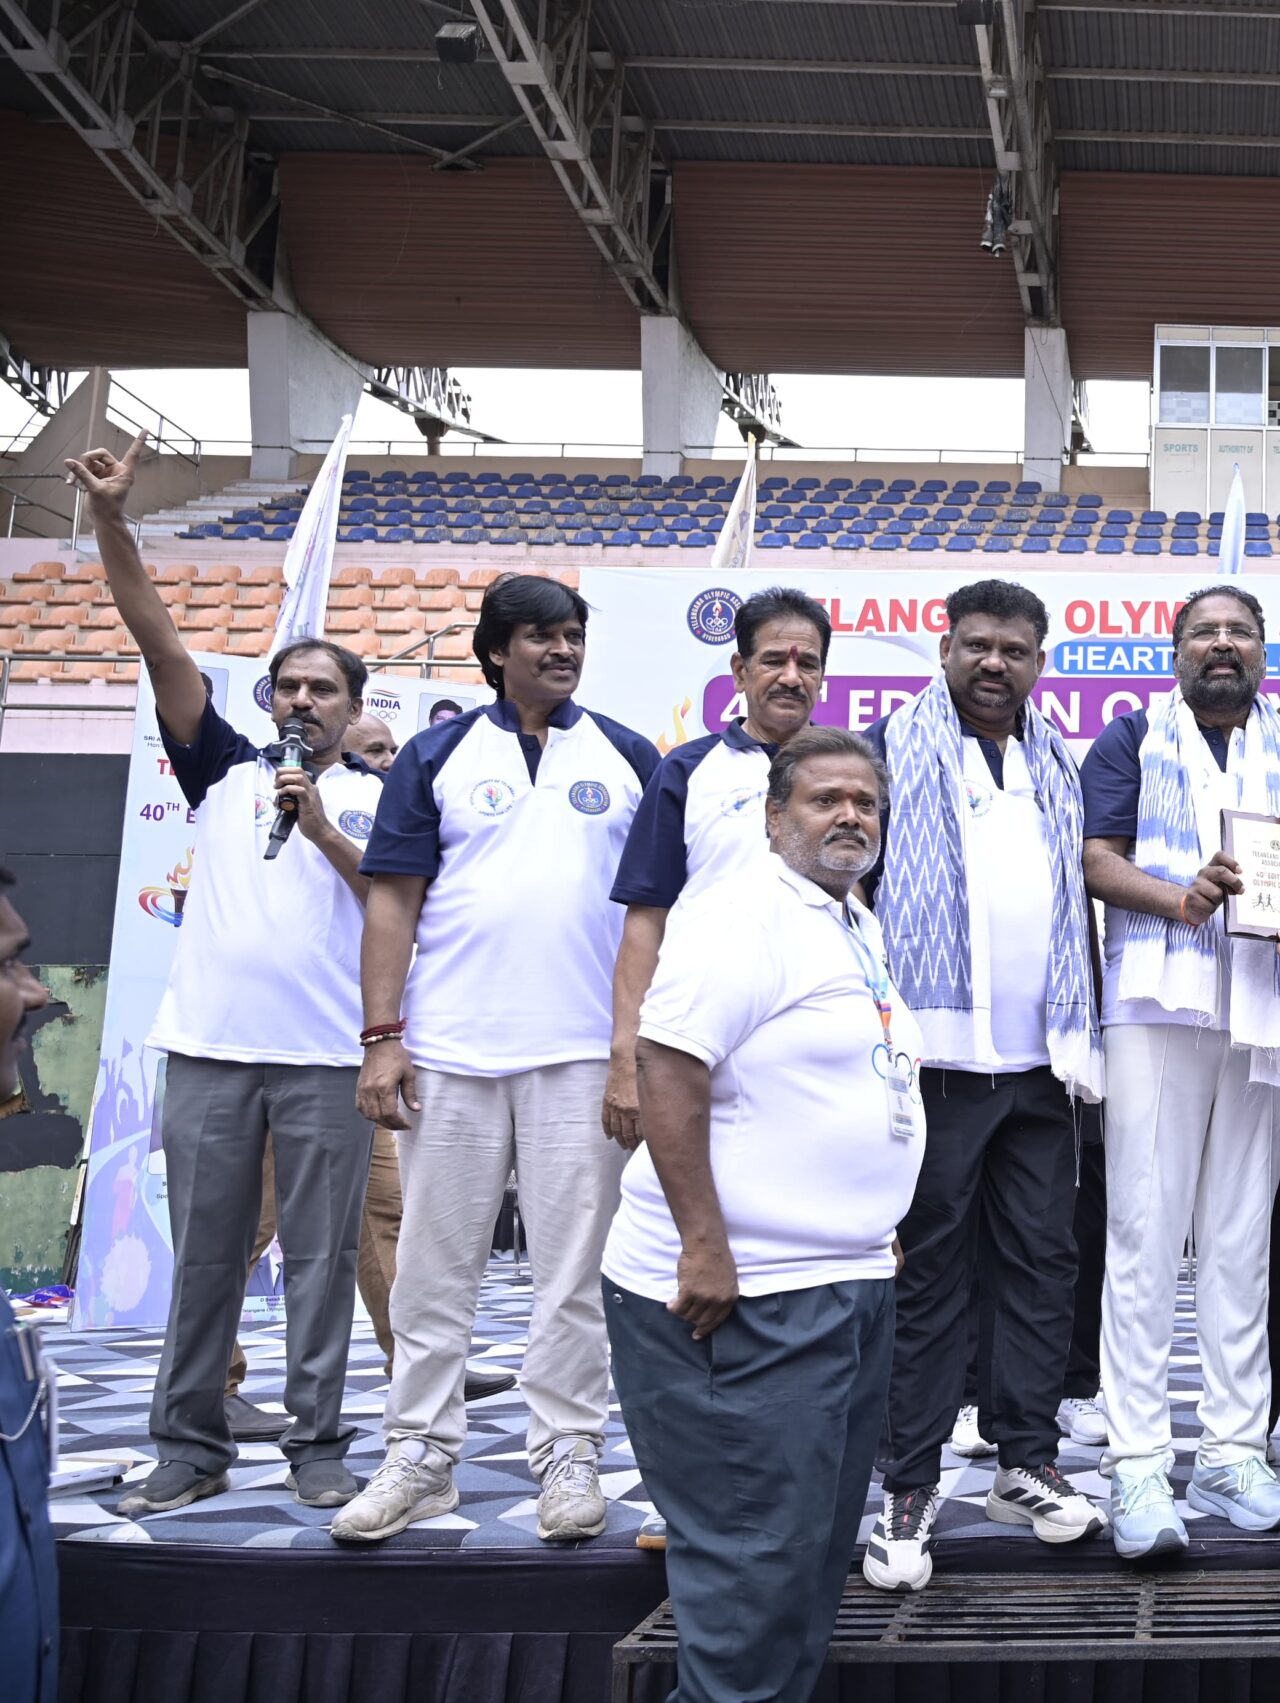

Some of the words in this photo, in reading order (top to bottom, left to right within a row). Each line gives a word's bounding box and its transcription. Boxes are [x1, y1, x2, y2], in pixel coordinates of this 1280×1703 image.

[1163, 443, 1199, 453] SPORTS
[703, 590, 731, 600] OLYMPIC
[1065, 600, 1186, 635] OLYM
[1063, 646, 1175, 671] HEART
[366, 697, 401, 710] INDIA
